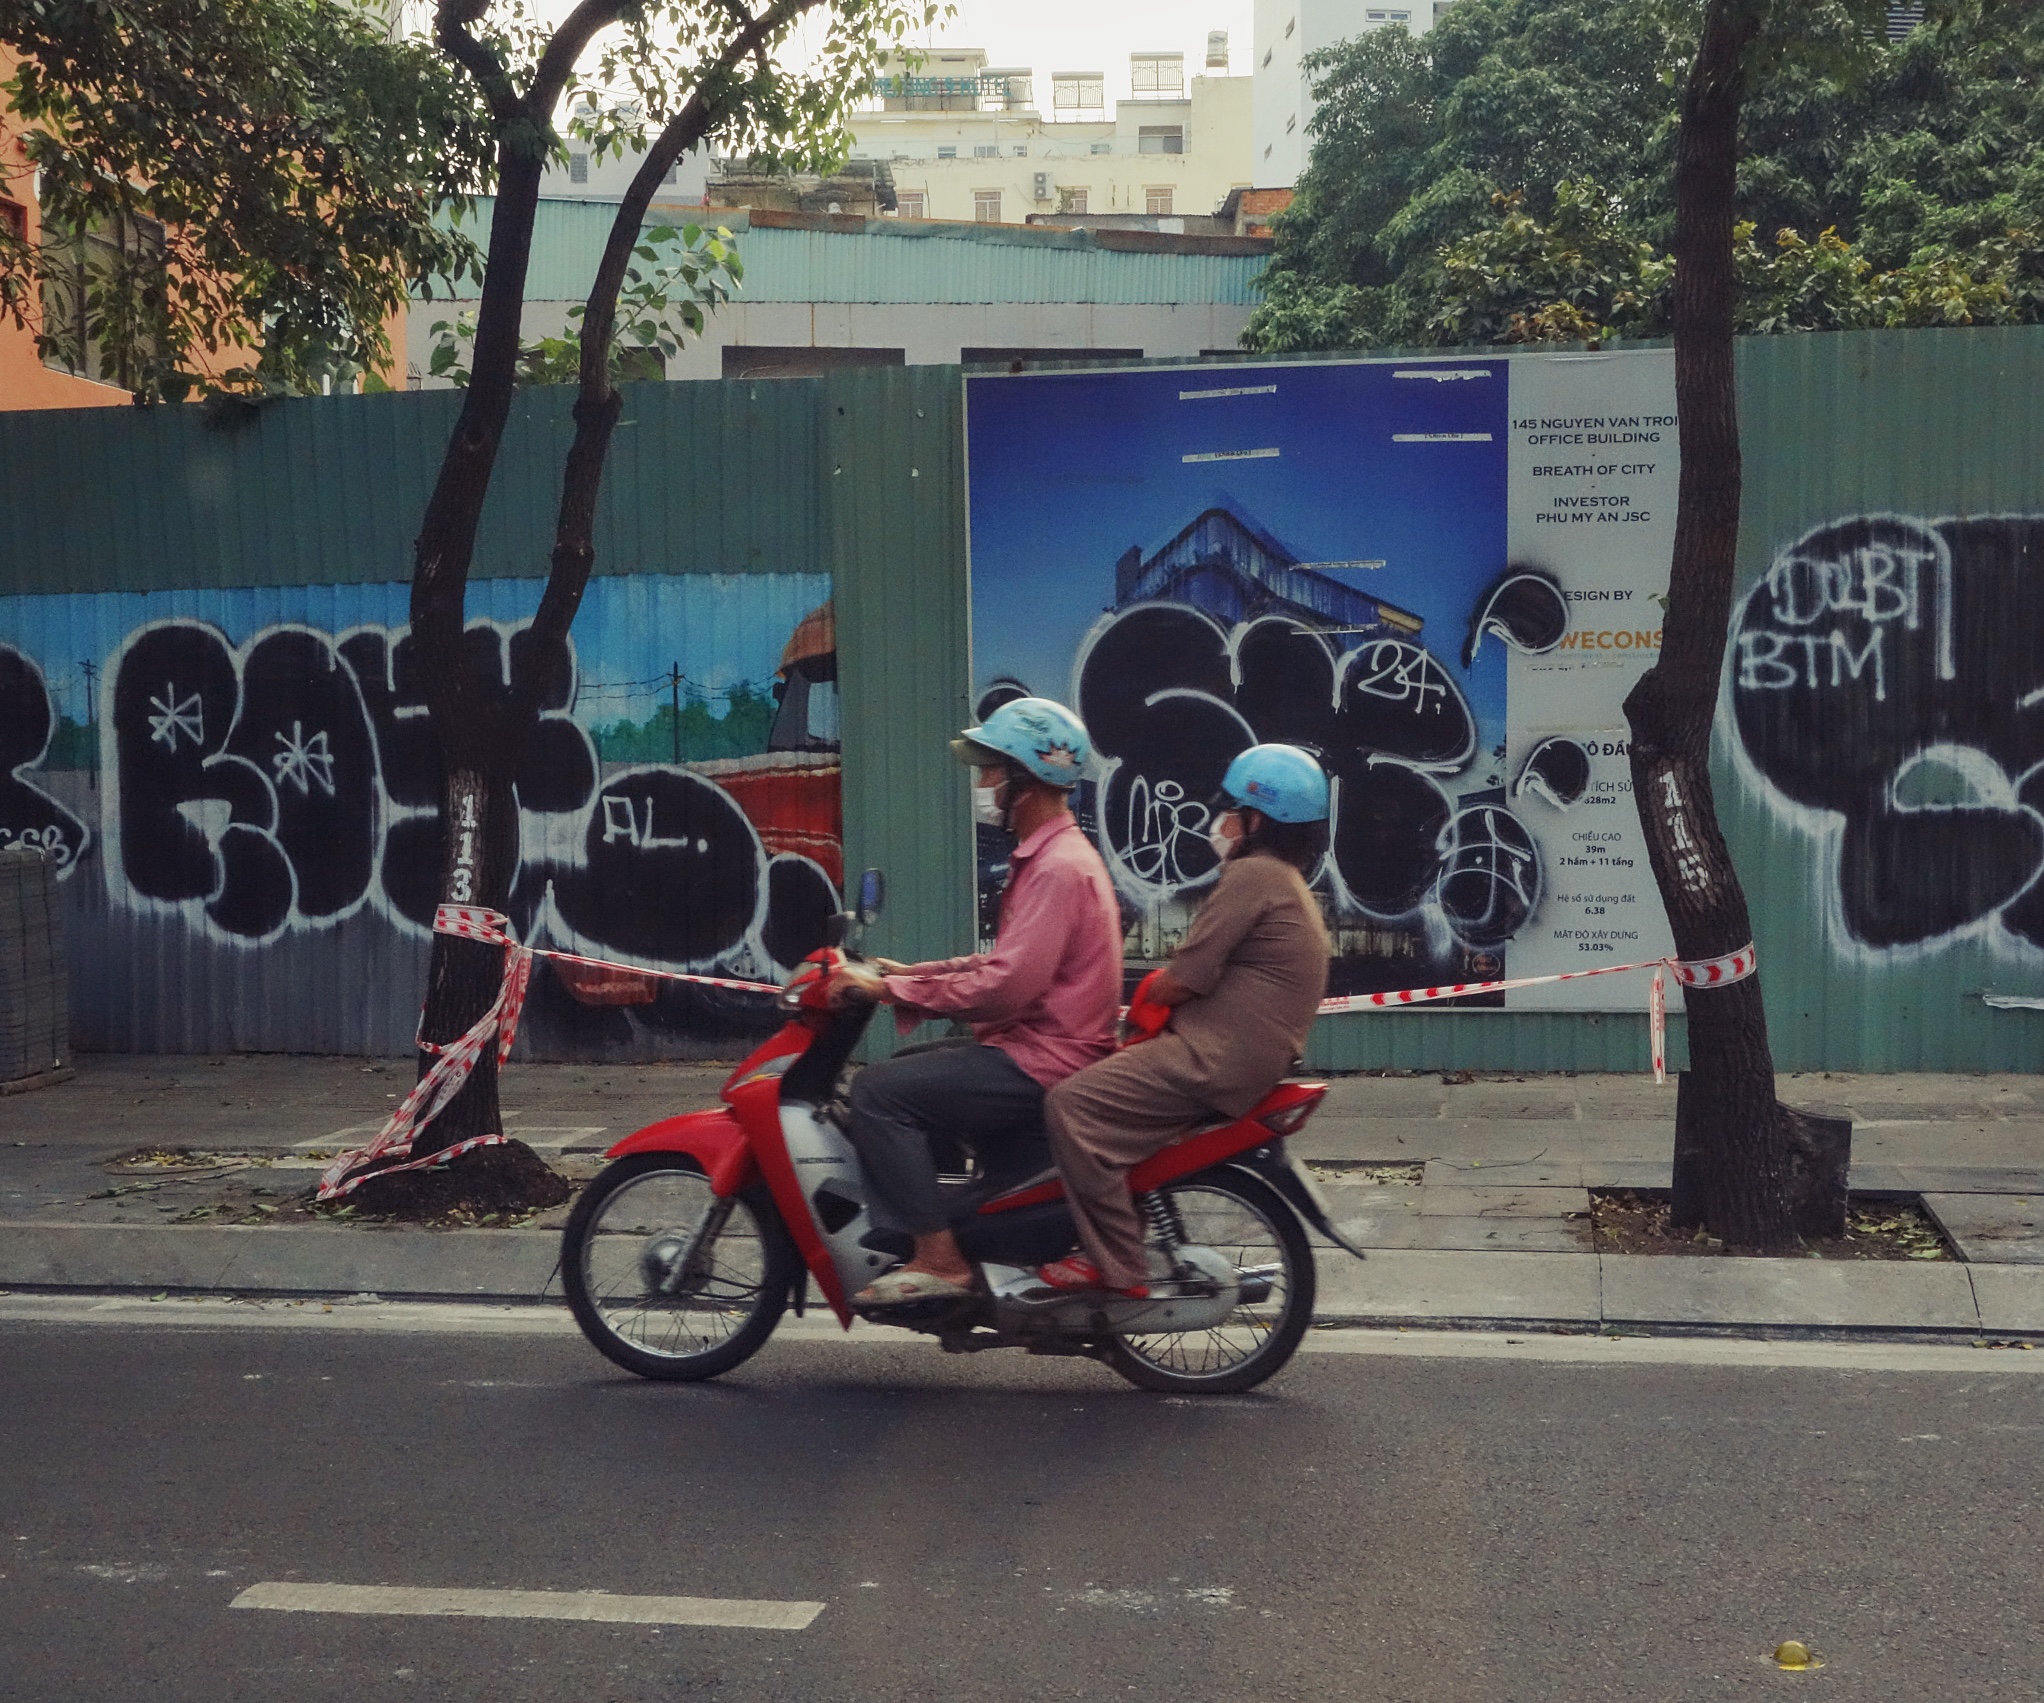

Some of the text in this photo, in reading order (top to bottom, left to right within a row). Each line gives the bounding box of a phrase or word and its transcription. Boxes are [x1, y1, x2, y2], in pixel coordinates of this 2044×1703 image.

[1513, 416, 1678, 429] 145 NGUYEN VAN TROI
[1528, 432, 1661, 445] OFFICE BUILDING
[1532, 464, 1656, 476] BREATH OF CITY
[1554, 497, 1630, 507] INVESTOR
[1536, 511, 1650, 523] PHU MY AN JSC
[1563, 590, 1633, 600] ESIGN BY
[1738, 625, 1885, 701] BTM
[1602, 832, 1622, 842] CAO
[450, 794, 478, 902] 113
[1585, 845, 1606, 854] 39m
[1559, 857, 1565, 866] 2
[1599, 857, 1609, 866] 11
[1585, 906, 1606, 915] 6.38
[1578, 943, 1614, 952] 53.03%
